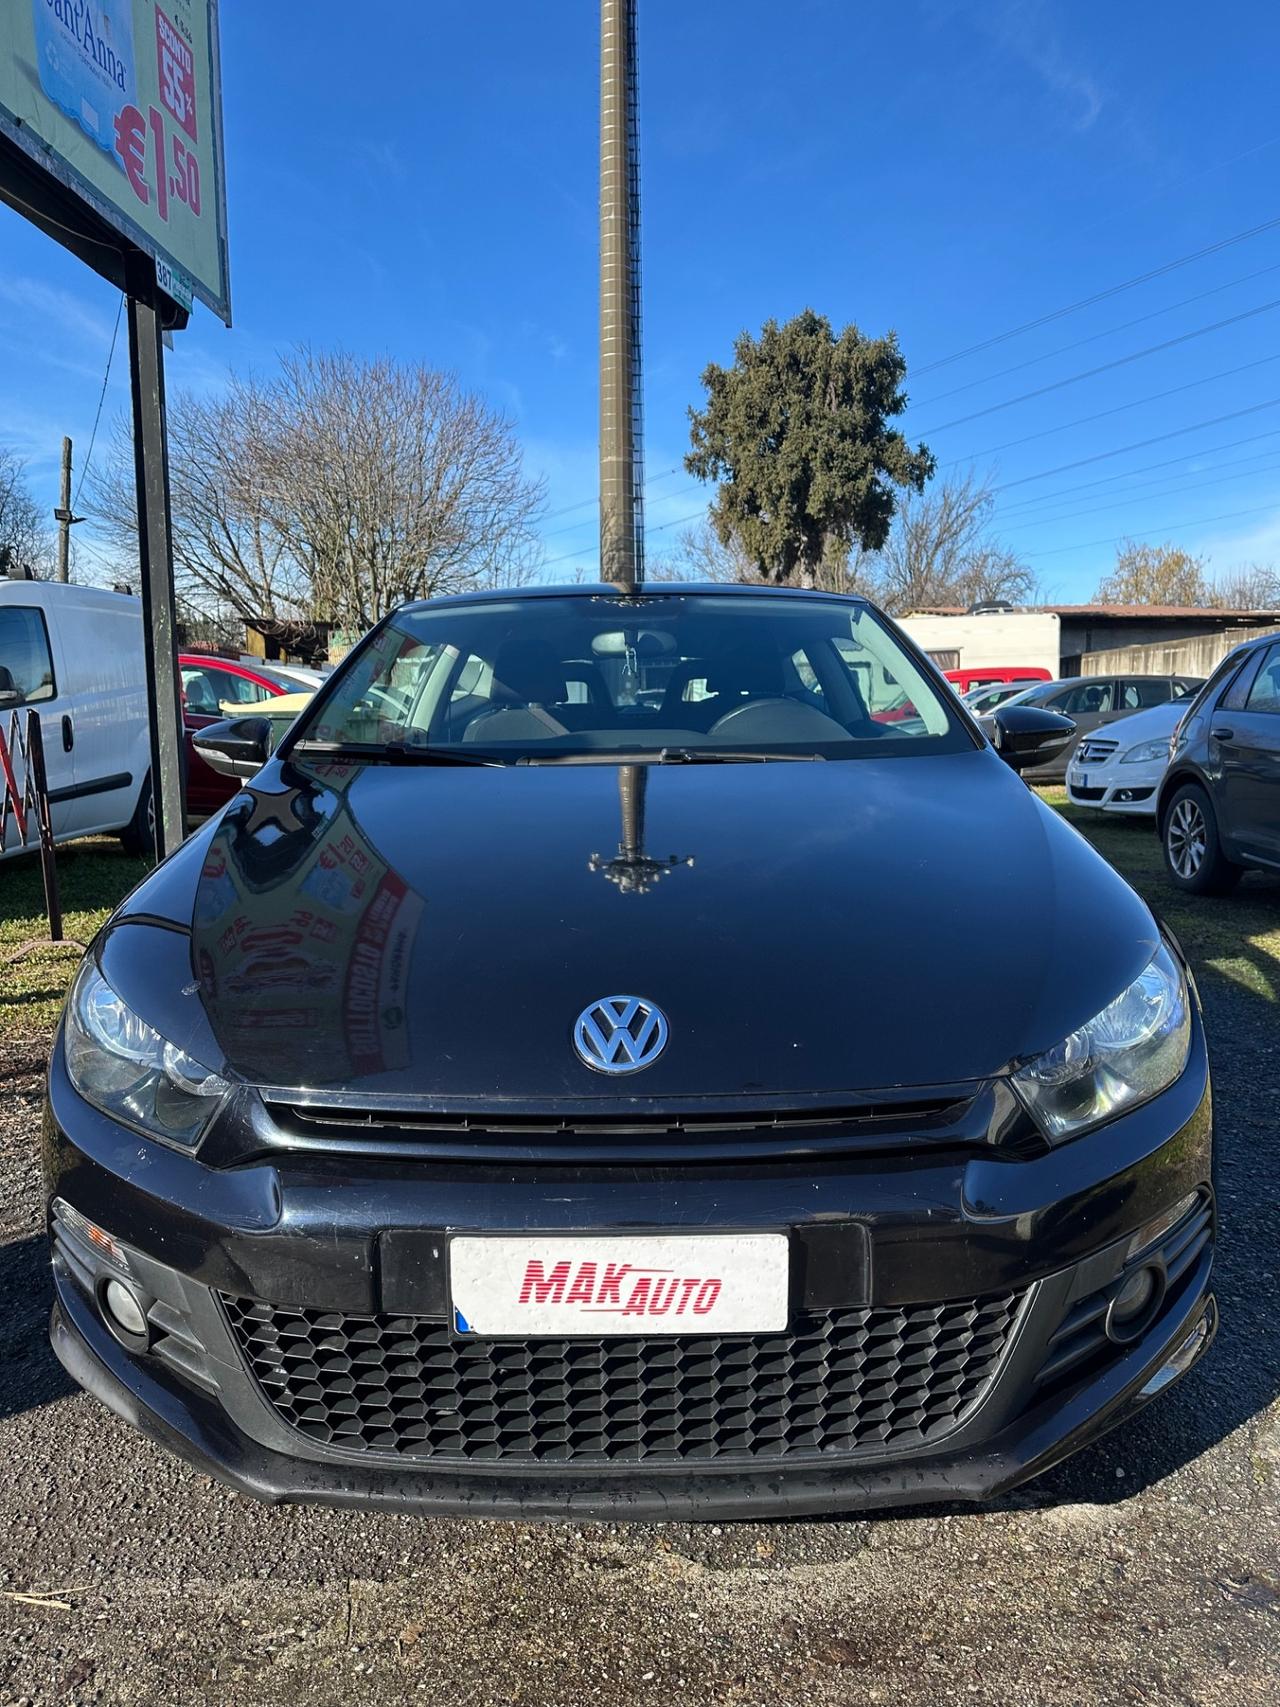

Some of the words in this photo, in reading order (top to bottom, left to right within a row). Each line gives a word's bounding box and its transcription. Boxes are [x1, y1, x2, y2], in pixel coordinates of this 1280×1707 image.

[46, 0, 127, 93] ant'Anna
[158, 14, 191, 75] SCONTO
[157, 260, 173, 290] 387
[518, 1260, 633, 1304] MAK
[621, 1278, 723, 1316] AUTO
